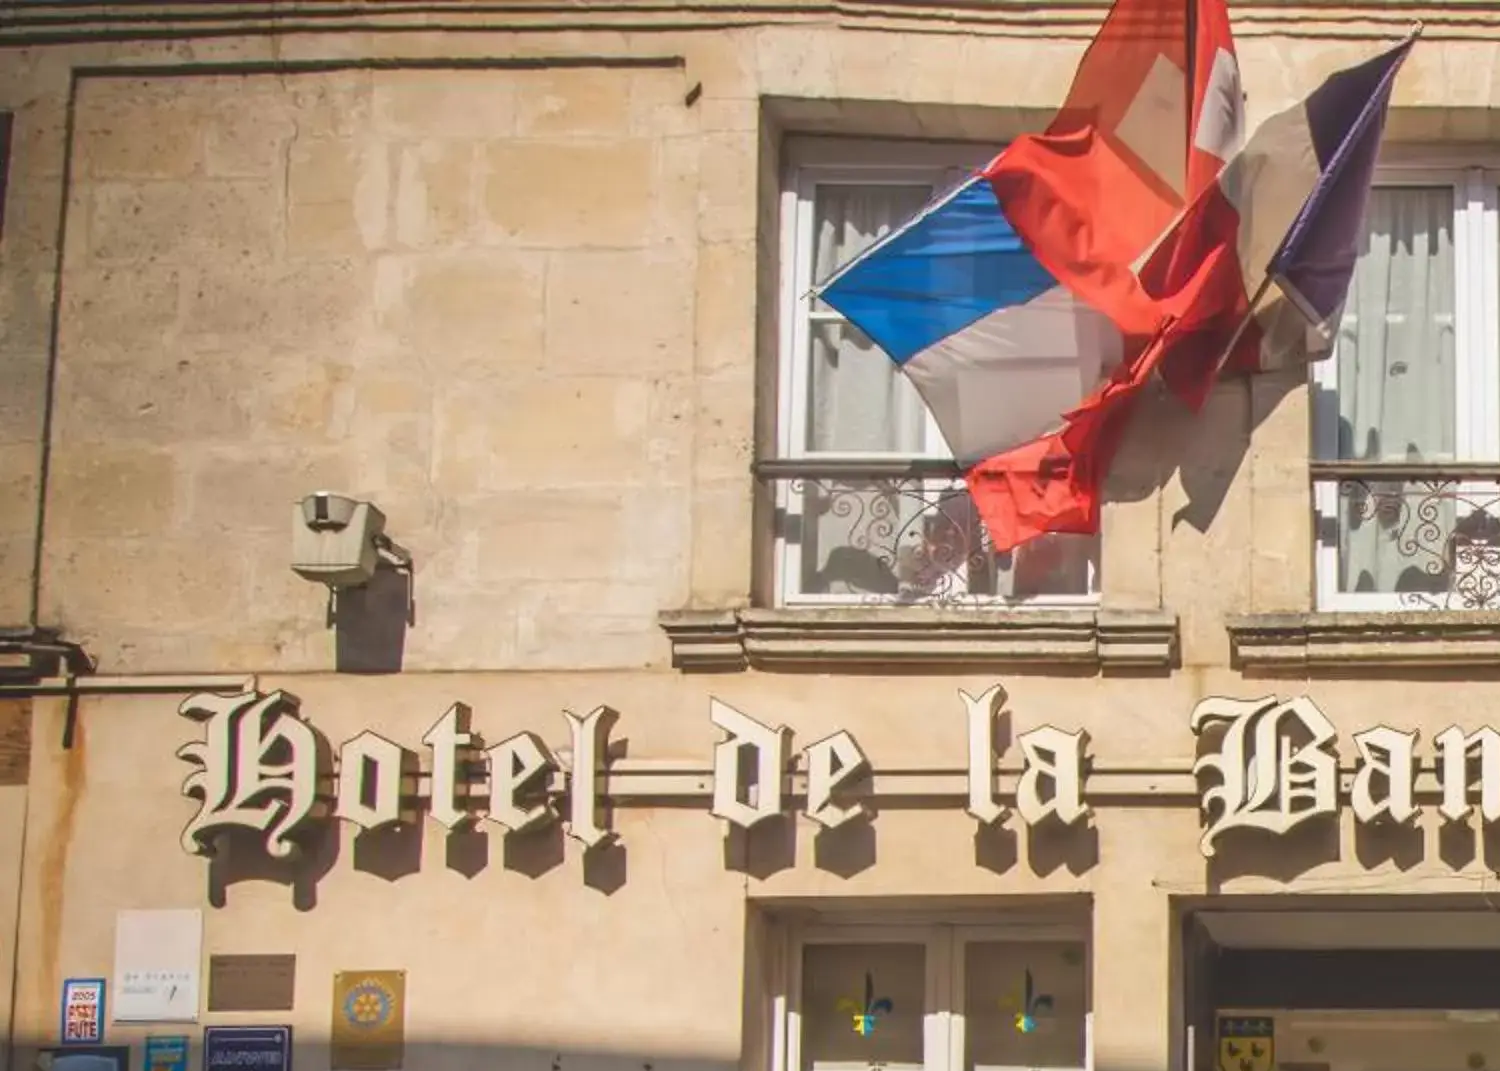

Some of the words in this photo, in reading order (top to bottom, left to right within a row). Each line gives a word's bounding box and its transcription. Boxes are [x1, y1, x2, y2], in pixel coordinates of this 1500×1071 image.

[178, 688, 623, 858] Hotel
[709, 695, 868, 829] de
[957, 684, 1089, 829] la
